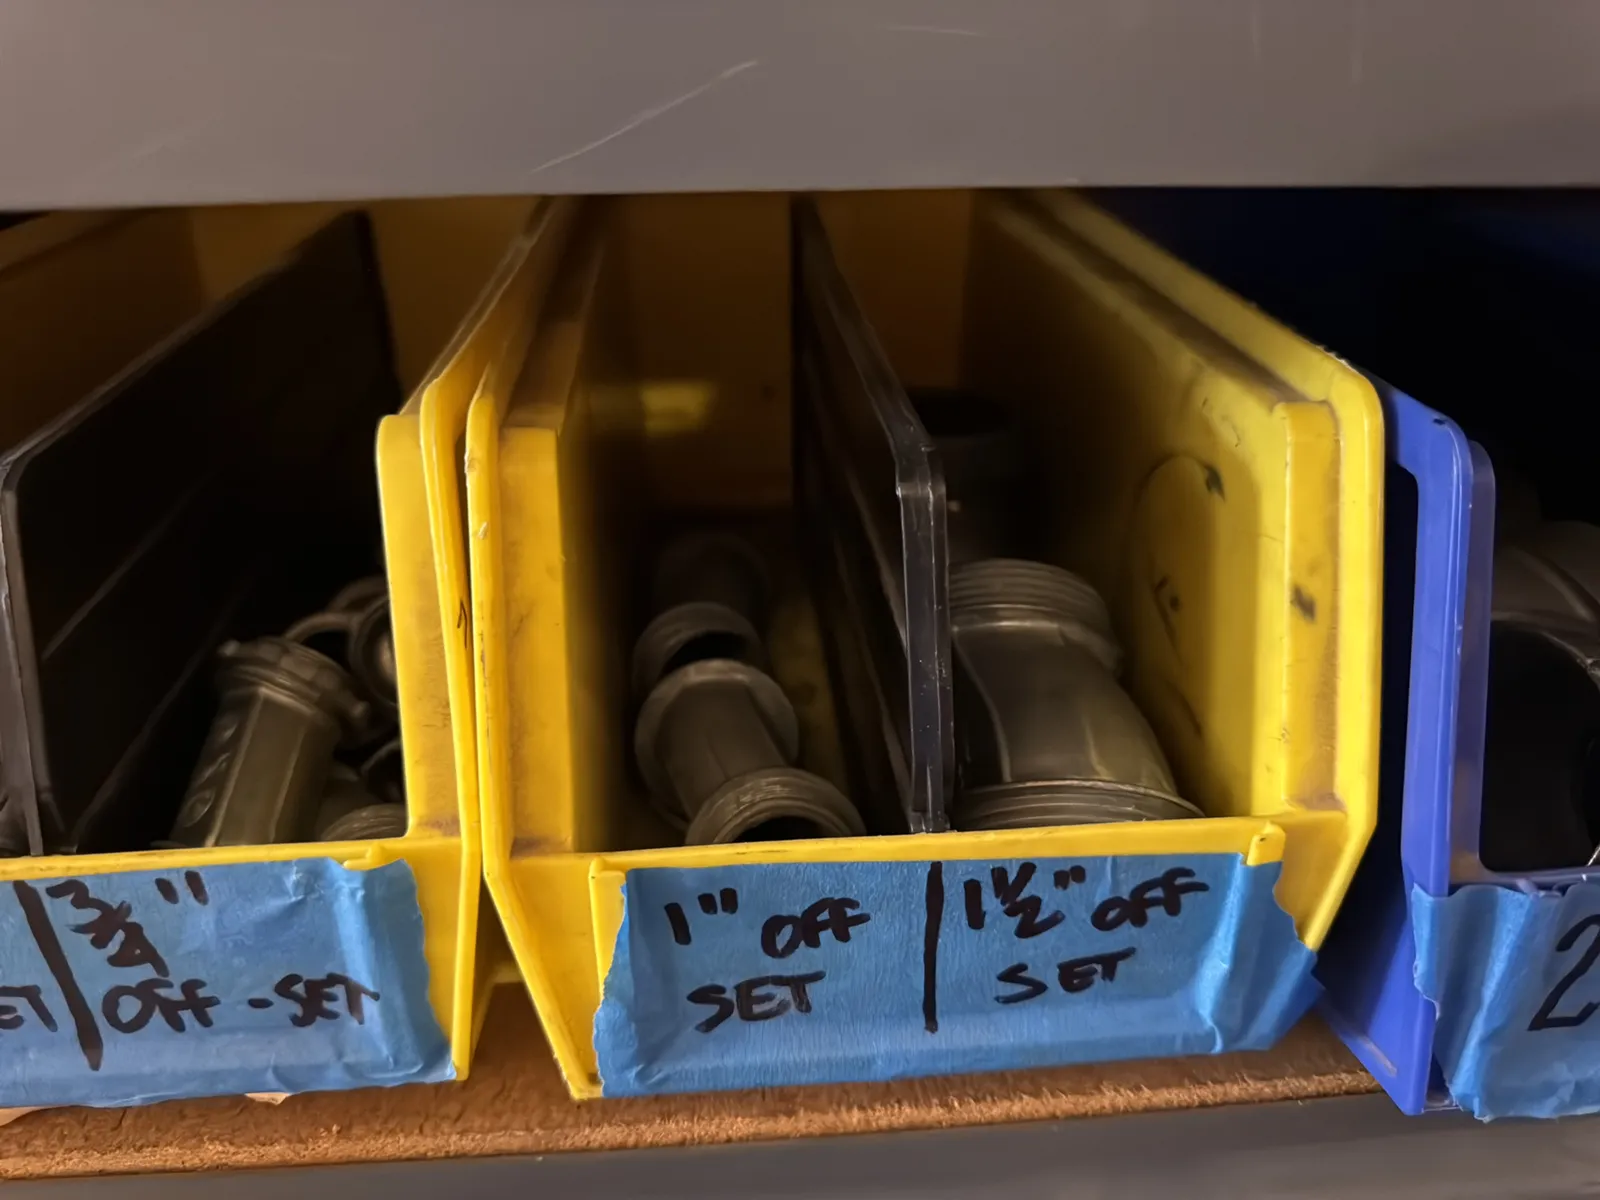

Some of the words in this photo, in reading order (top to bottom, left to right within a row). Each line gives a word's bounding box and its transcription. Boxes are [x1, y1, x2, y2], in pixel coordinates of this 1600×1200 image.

[760, 897, 871, 958] OFF
[1090, 867, 1209, 934] OFF
[686, 971, 826, 1034] SET
[994, 947, 1136, 1004] SET
